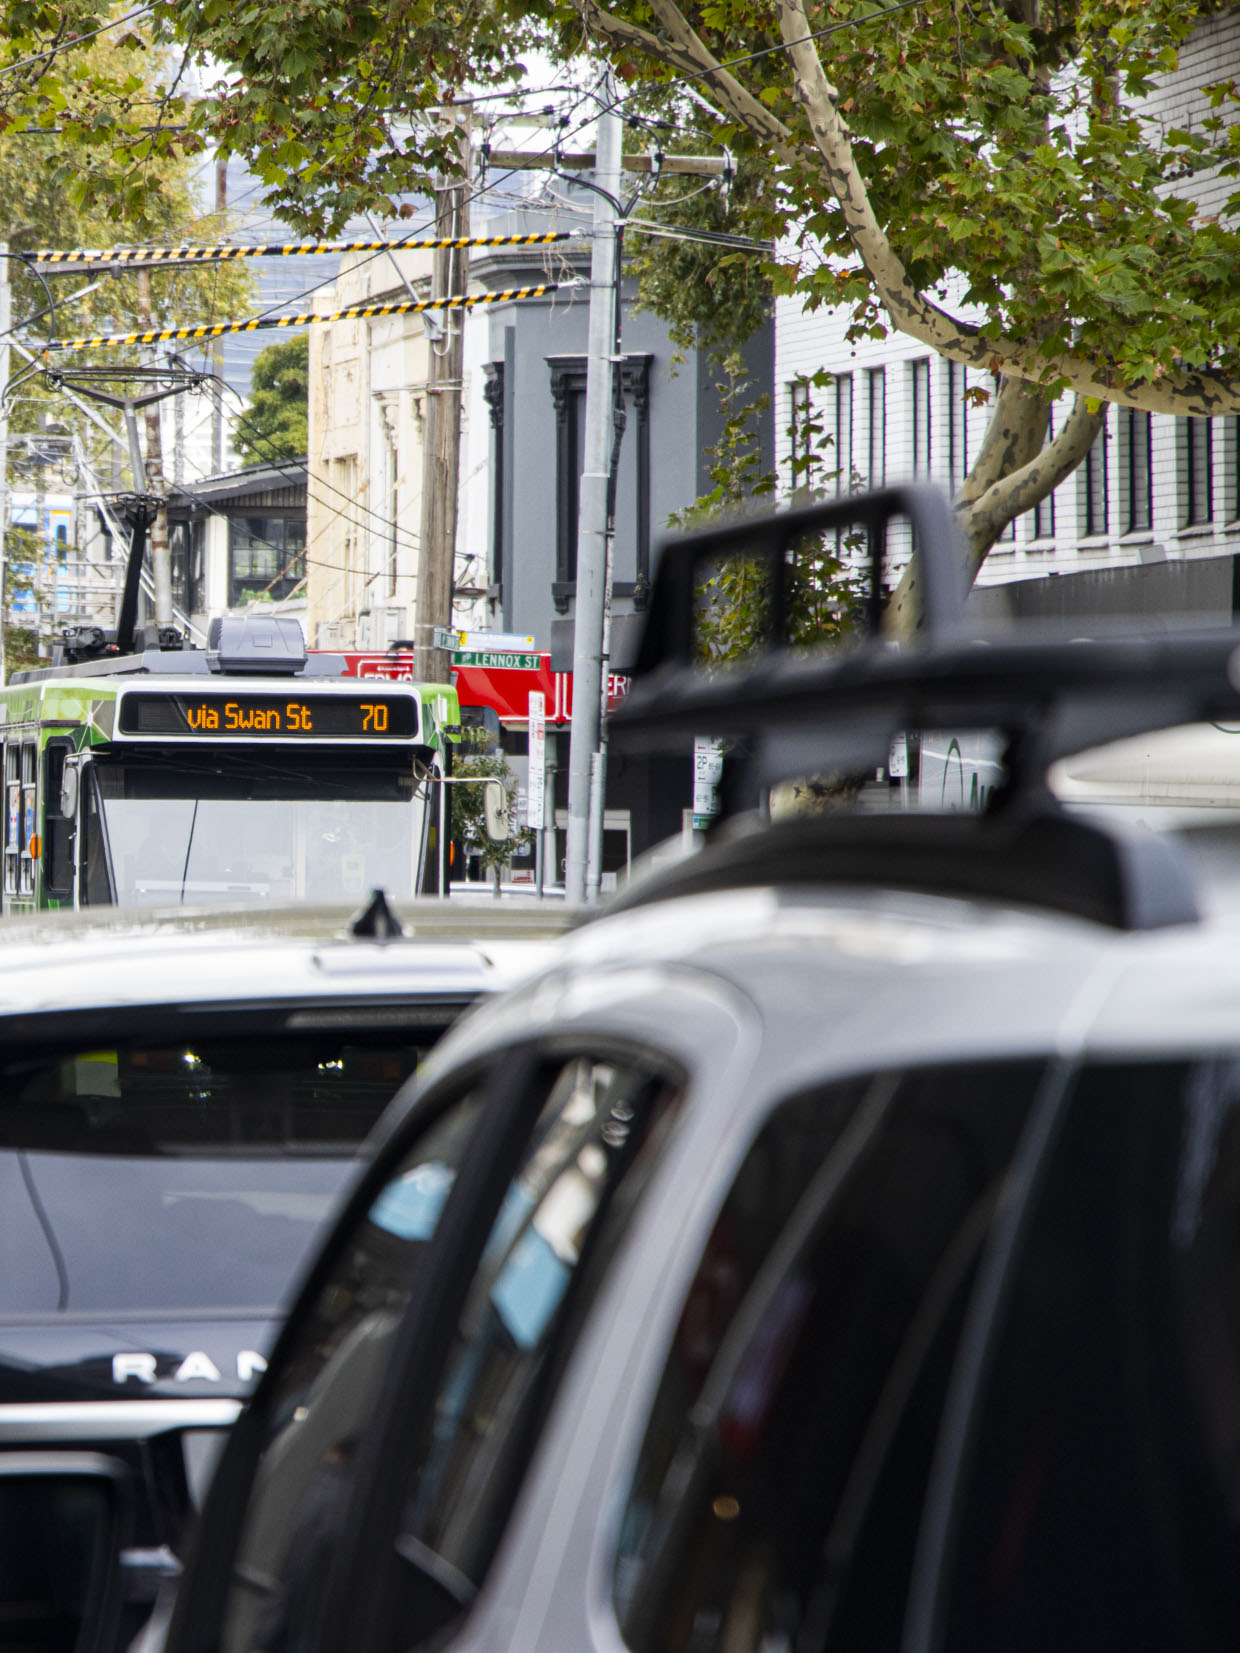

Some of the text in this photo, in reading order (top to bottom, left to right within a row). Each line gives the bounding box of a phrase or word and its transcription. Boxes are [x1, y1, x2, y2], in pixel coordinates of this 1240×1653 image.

[475, 653, 539, 669] LENNOX ST
[187, 703, 388, 731] via Swan St 70
[112, 1349, 268, 1384] RAN
